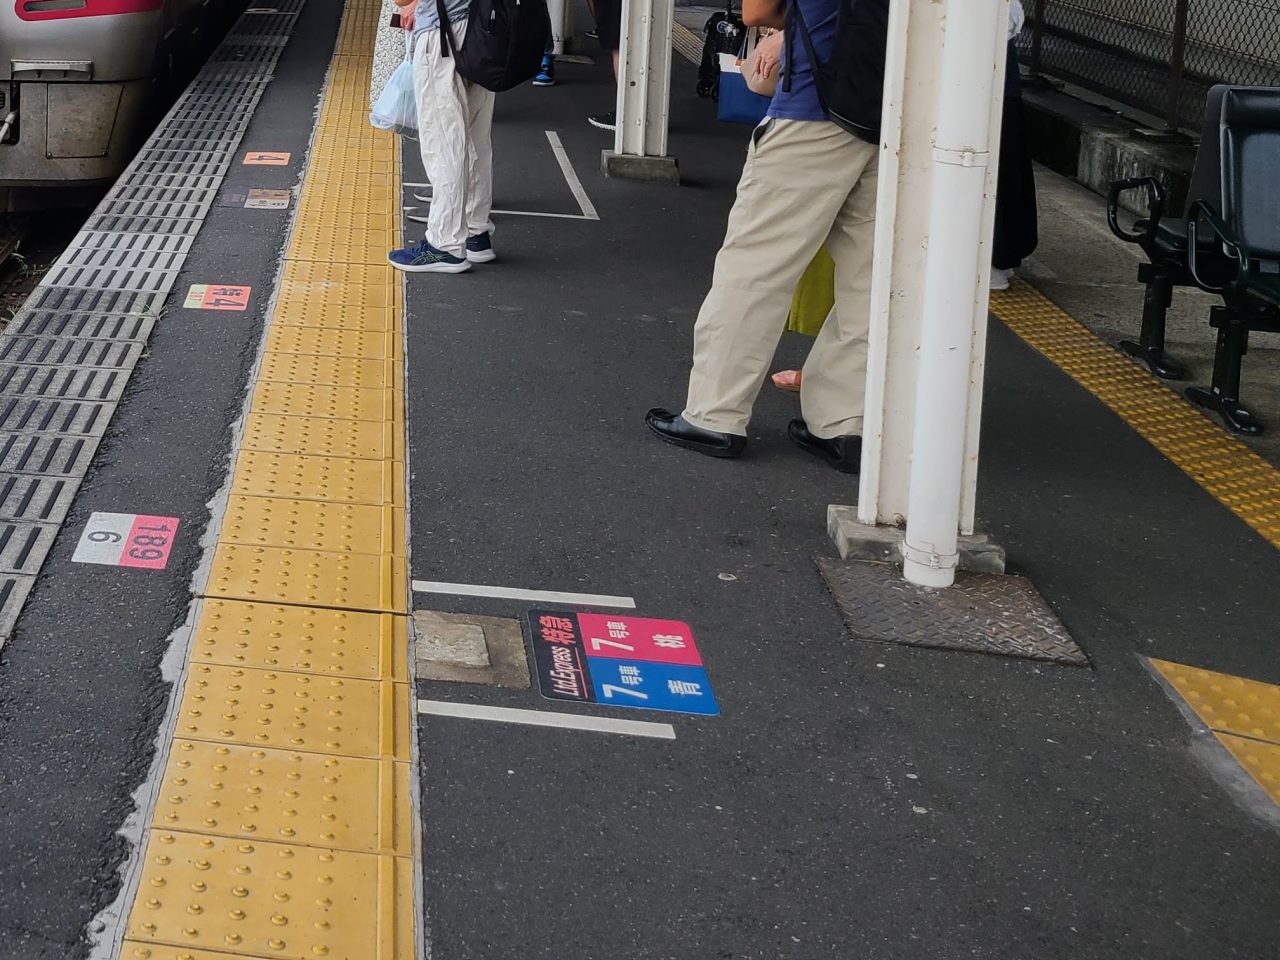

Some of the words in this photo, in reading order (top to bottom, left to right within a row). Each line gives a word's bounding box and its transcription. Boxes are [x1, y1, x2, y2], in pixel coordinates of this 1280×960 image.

[128, 524, 172, 560] 189
[538, 615, 576, 646] 特急
[651, 633, 687, 649] 桃
[549, 645, 582, 697] Ltd.Express
[667, 679, 704, 696] 青
